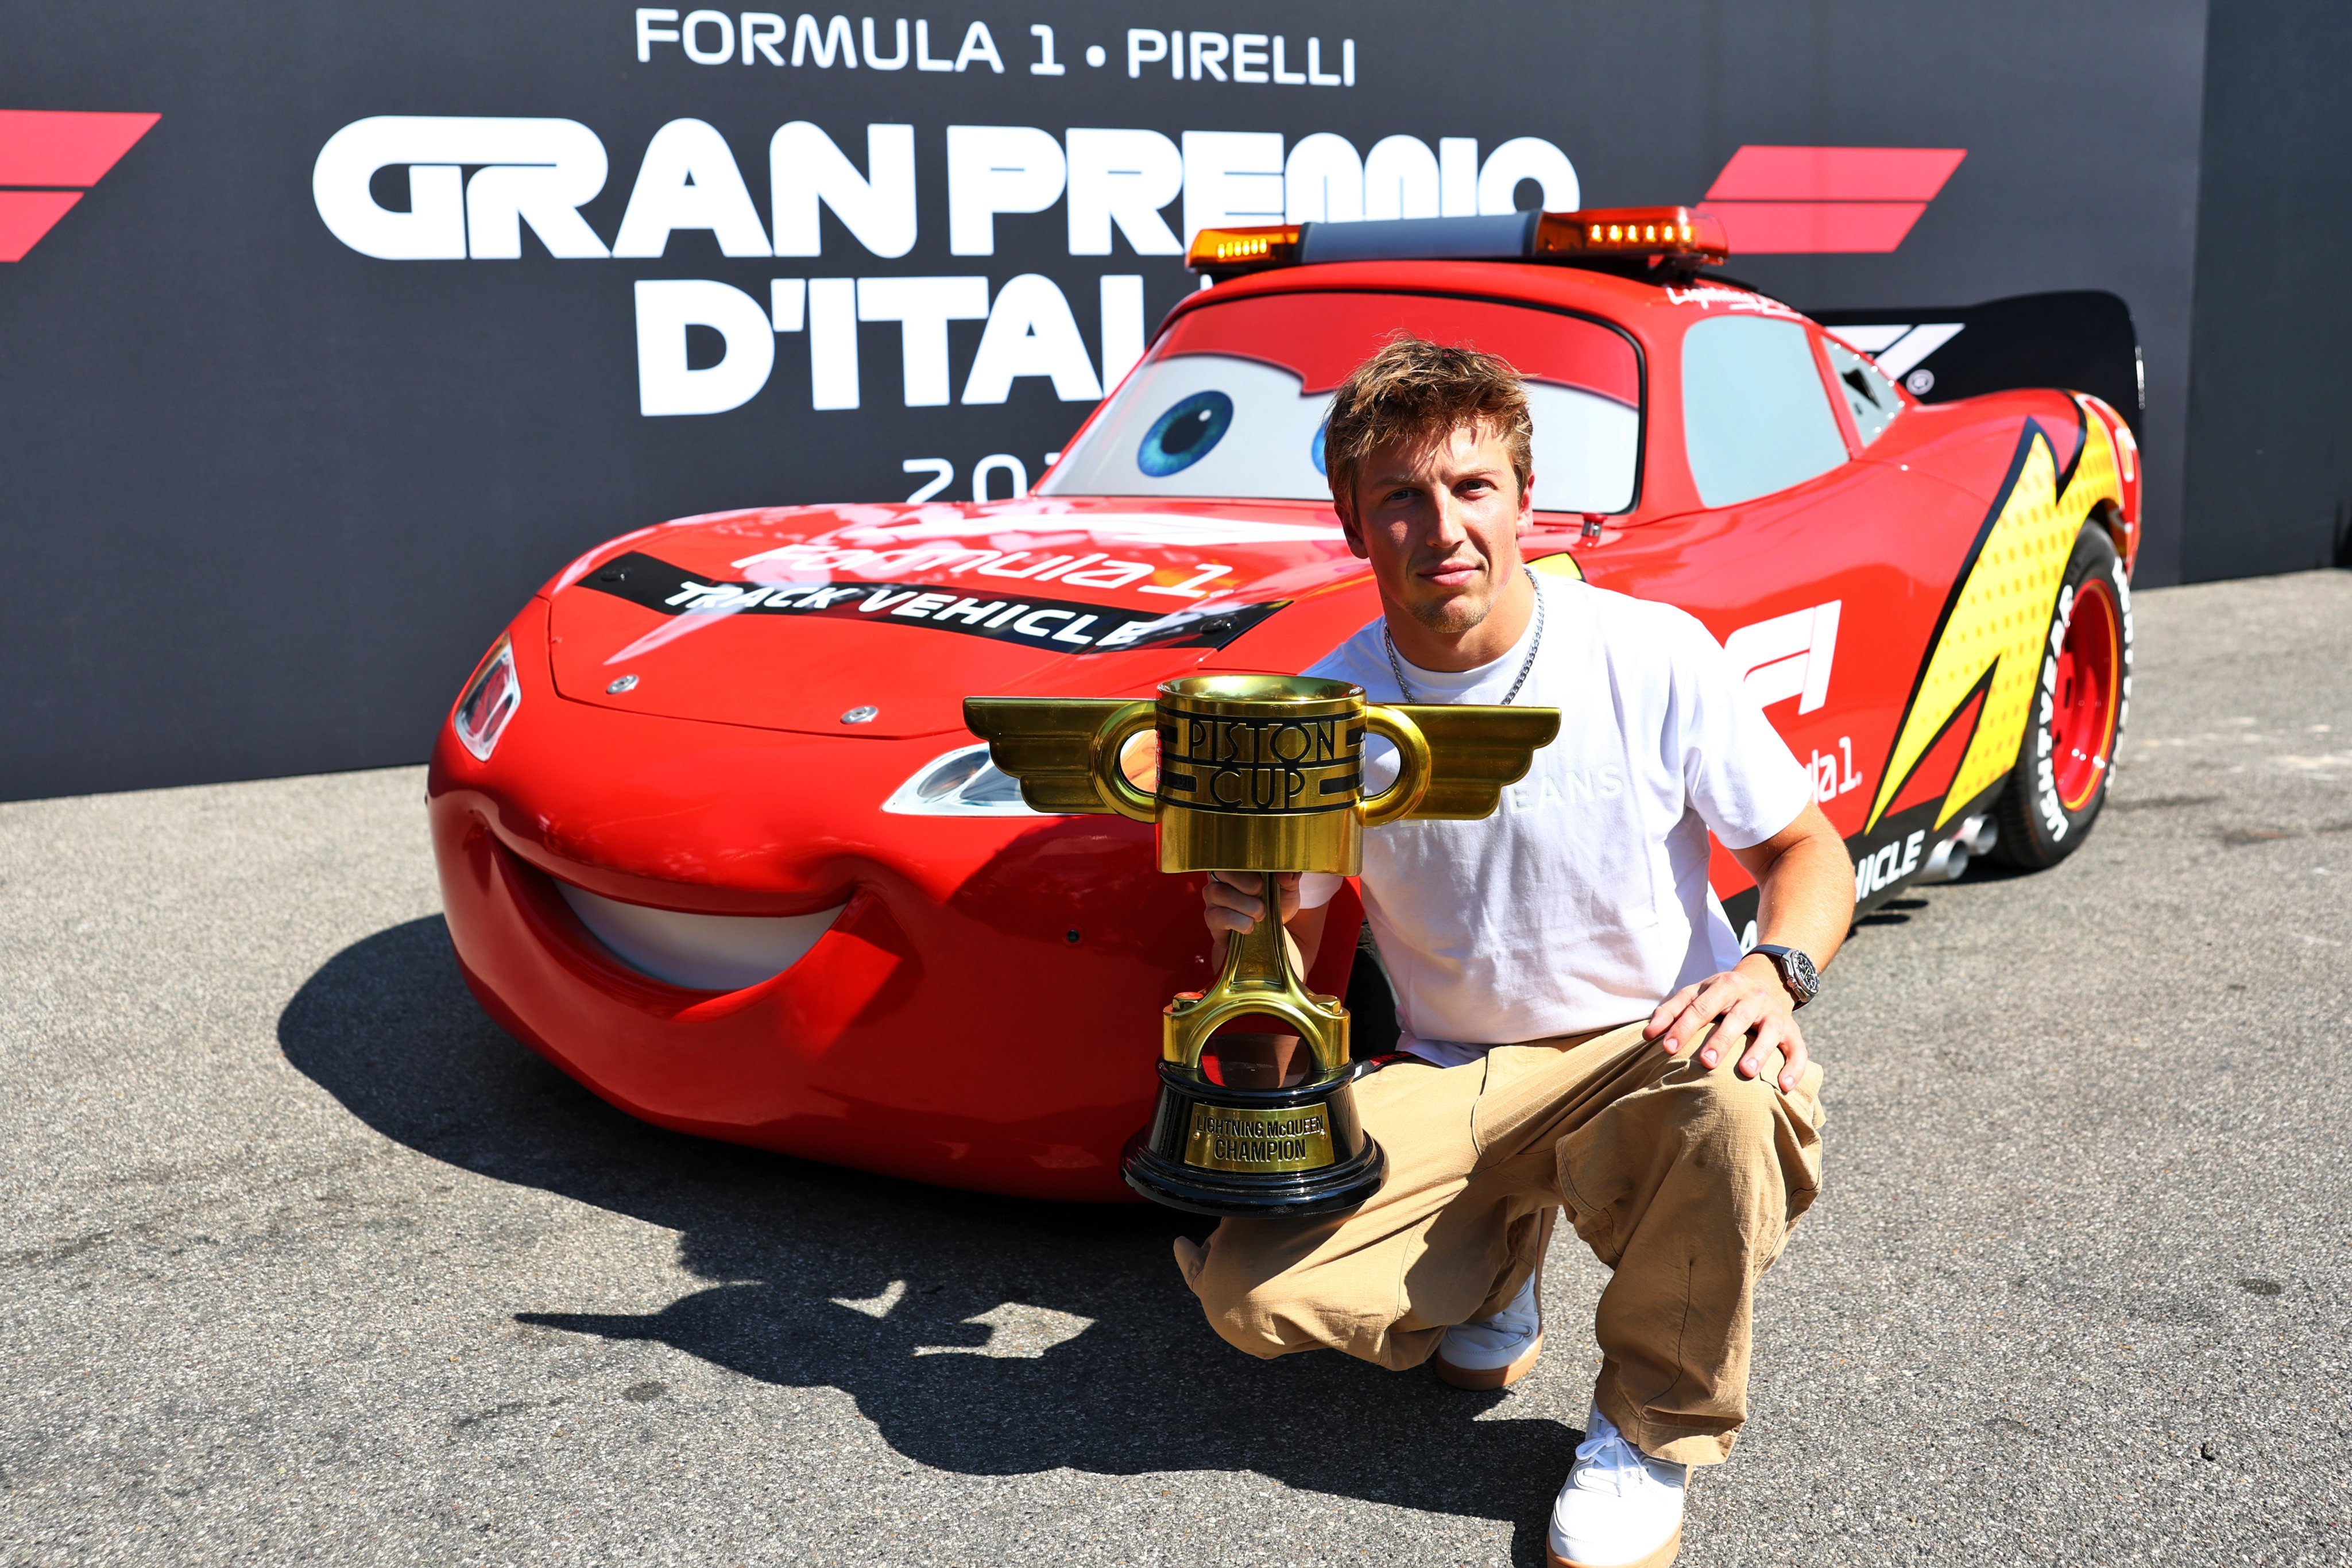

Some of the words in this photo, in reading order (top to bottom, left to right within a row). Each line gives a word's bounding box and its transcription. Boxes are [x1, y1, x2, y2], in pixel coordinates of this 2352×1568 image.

[636, 8, 1004, 73] FORMULA
[1030, 24, 1065, 75] 1
[1127, 28, 1355, 87] PIRELLI
[312, 115, 917, 260] GRAN
[947, 125, 1580, 255] PREMIO
[902, 452, 1061, 504] 20
[730, 543, 1155, 589] Formula
[664, 580, 860, 610] TRACK
[858, 589, 1165, 646] VEHICLE
[1189, 718, 1336, 765] PISTON
[1209, 767, 1305, 809] CUP
[1494, 763, 1624, 815] EANS
[1196, 1114, 1264, 1139] LIGHTNING
[1266, 1115, 1325, 1139] McQUEEN
[1213, 1139, 1307, 1163] CHAMPION
